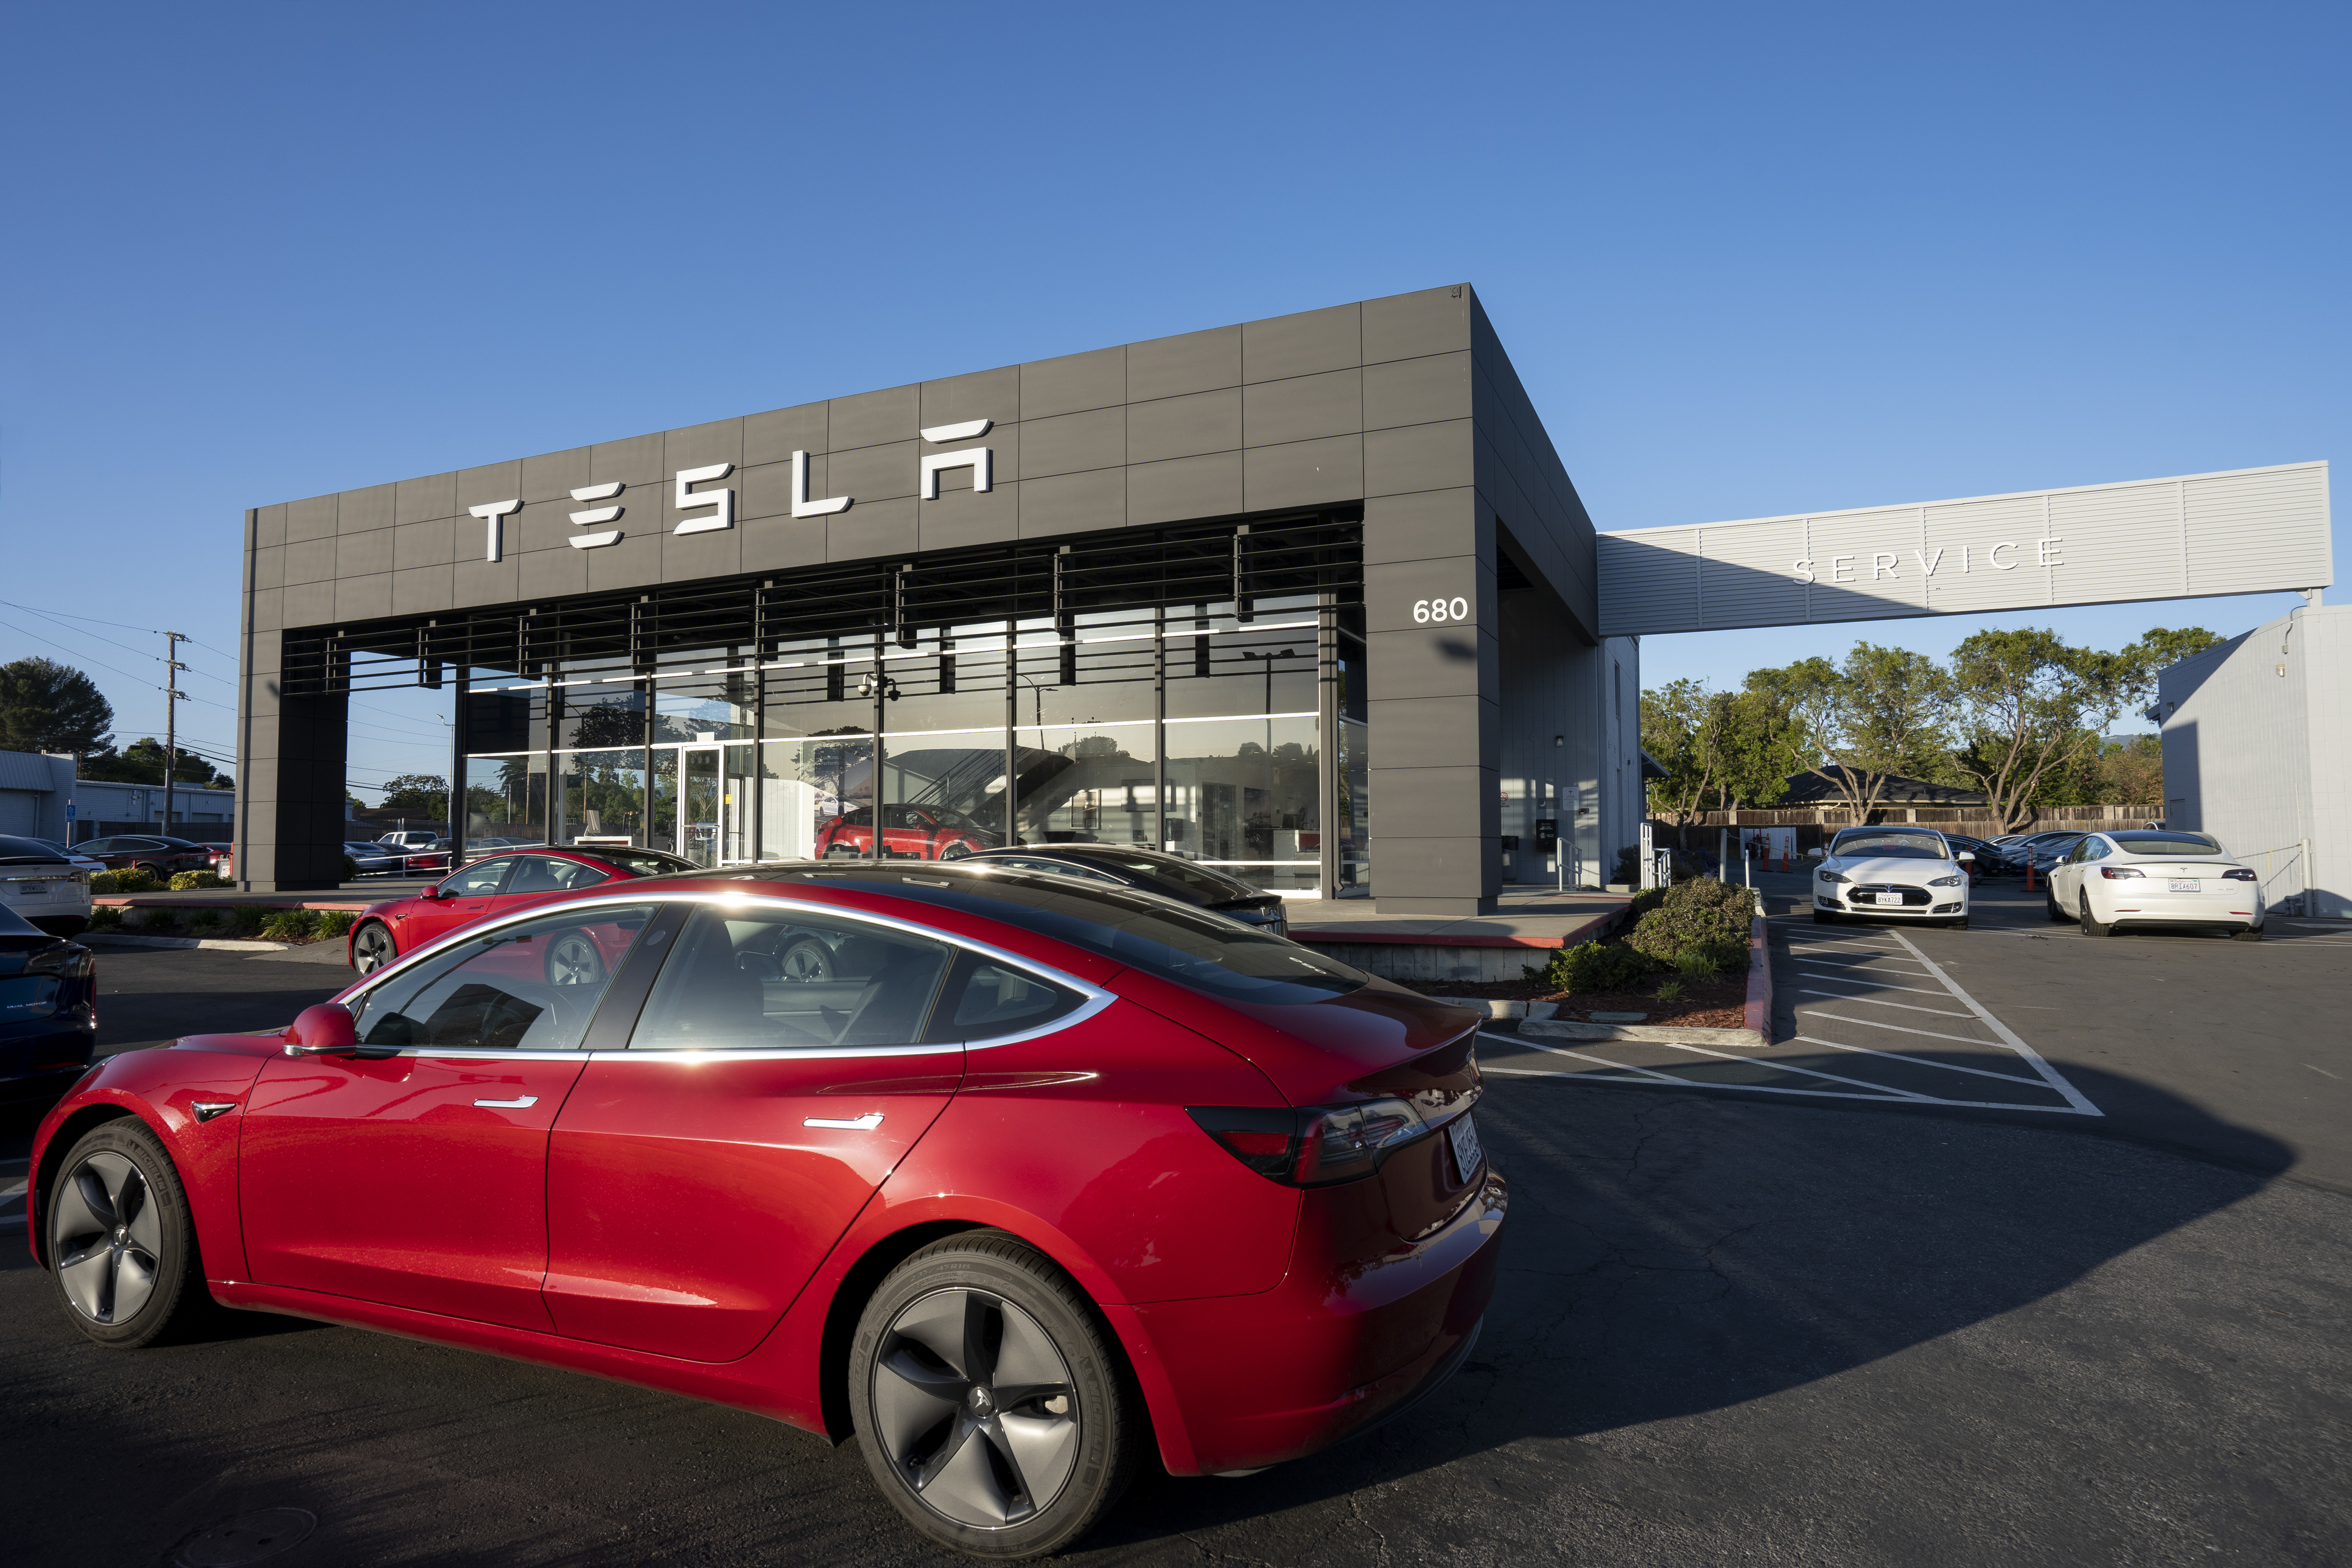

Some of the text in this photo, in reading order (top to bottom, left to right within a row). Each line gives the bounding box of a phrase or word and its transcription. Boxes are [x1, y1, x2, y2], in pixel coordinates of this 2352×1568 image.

[468, 418, 990, 562] TESLA
[1793, 537, 2064, 585] SERVICE
[1413, 597, 1468, 623] 680
[135, 1146, 166, 1191] MICHELIN
[1041, 1311, 1053, 1325] EXTRA
[1052, 1324, 1062, 1335] LOAD
[855, 1353, 866, 1432] MICHELIN
[1087, 1379, 1103, 1465] MICHELIN
